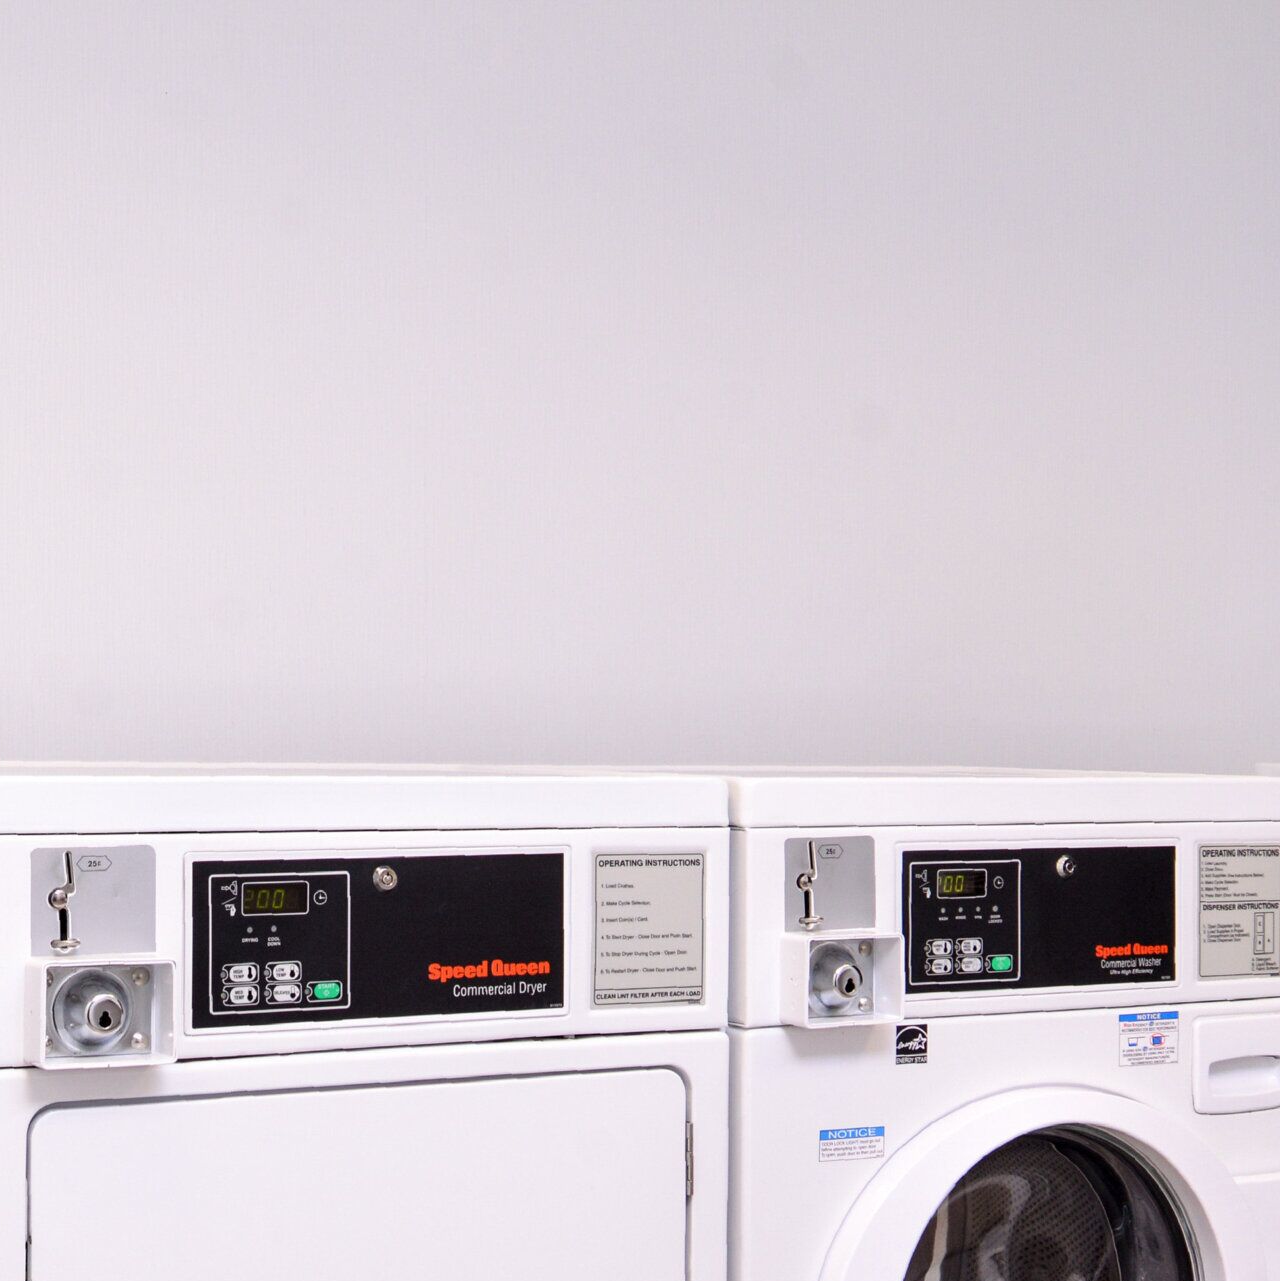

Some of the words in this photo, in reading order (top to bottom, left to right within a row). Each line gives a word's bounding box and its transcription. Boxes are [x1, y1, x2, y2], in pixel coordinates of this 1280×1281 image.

[1202, 849, 1236, 857] OPERATING
[1237, 849, 1280, 857] INSTRUCTIONS
[598, 859, 643, 867] OPERATING
[1095, 943, 1131, 959] Speed
[1132, 943, 1168, 955] Queen
[1101, 958, 1137, 969] Commercial
[1138, 957, 1161, 967] Washer
[428, 960, 488, 983] Speed
[491, 959, 550, 976] Queen
[453, 982, 515, 997] Commercial
[519, 981, 547, 995] Dryer
[828, 1128, 876, 1139] NOTICE
